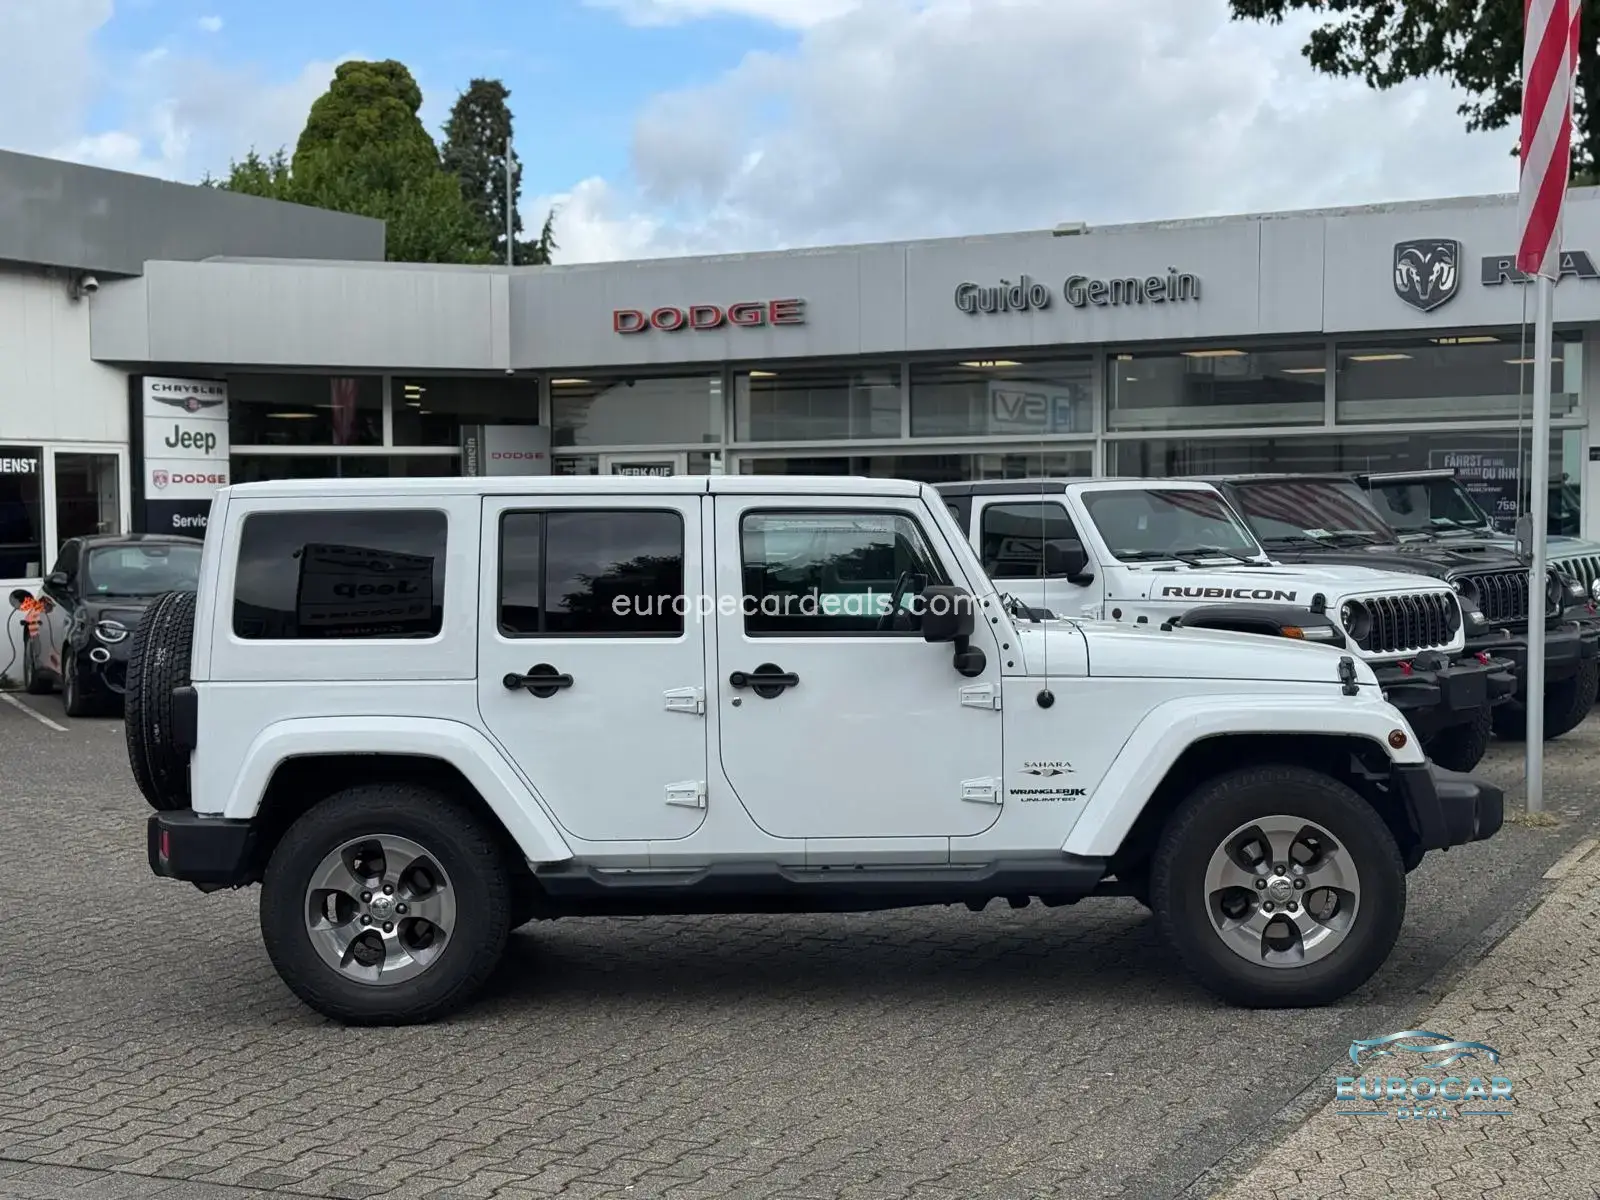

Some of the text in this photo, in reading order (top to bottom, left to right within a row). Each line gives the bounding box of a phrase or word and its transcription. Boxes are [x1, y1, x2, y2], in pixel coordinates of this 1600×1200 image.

[954, 266, 1200, 314] Guido Gemein
[613, 298, 805, 333] DODGE
[151, 383, 224, 396] CHRYSLER
[165, 424, 216, 455] Jeep
[491, 452, 545, 460] DODGE
[172, 473, 226, 485] DODGE
[172, 513, 208, 528] Servic
[1162, 586, 1297, 601] RUBICON
